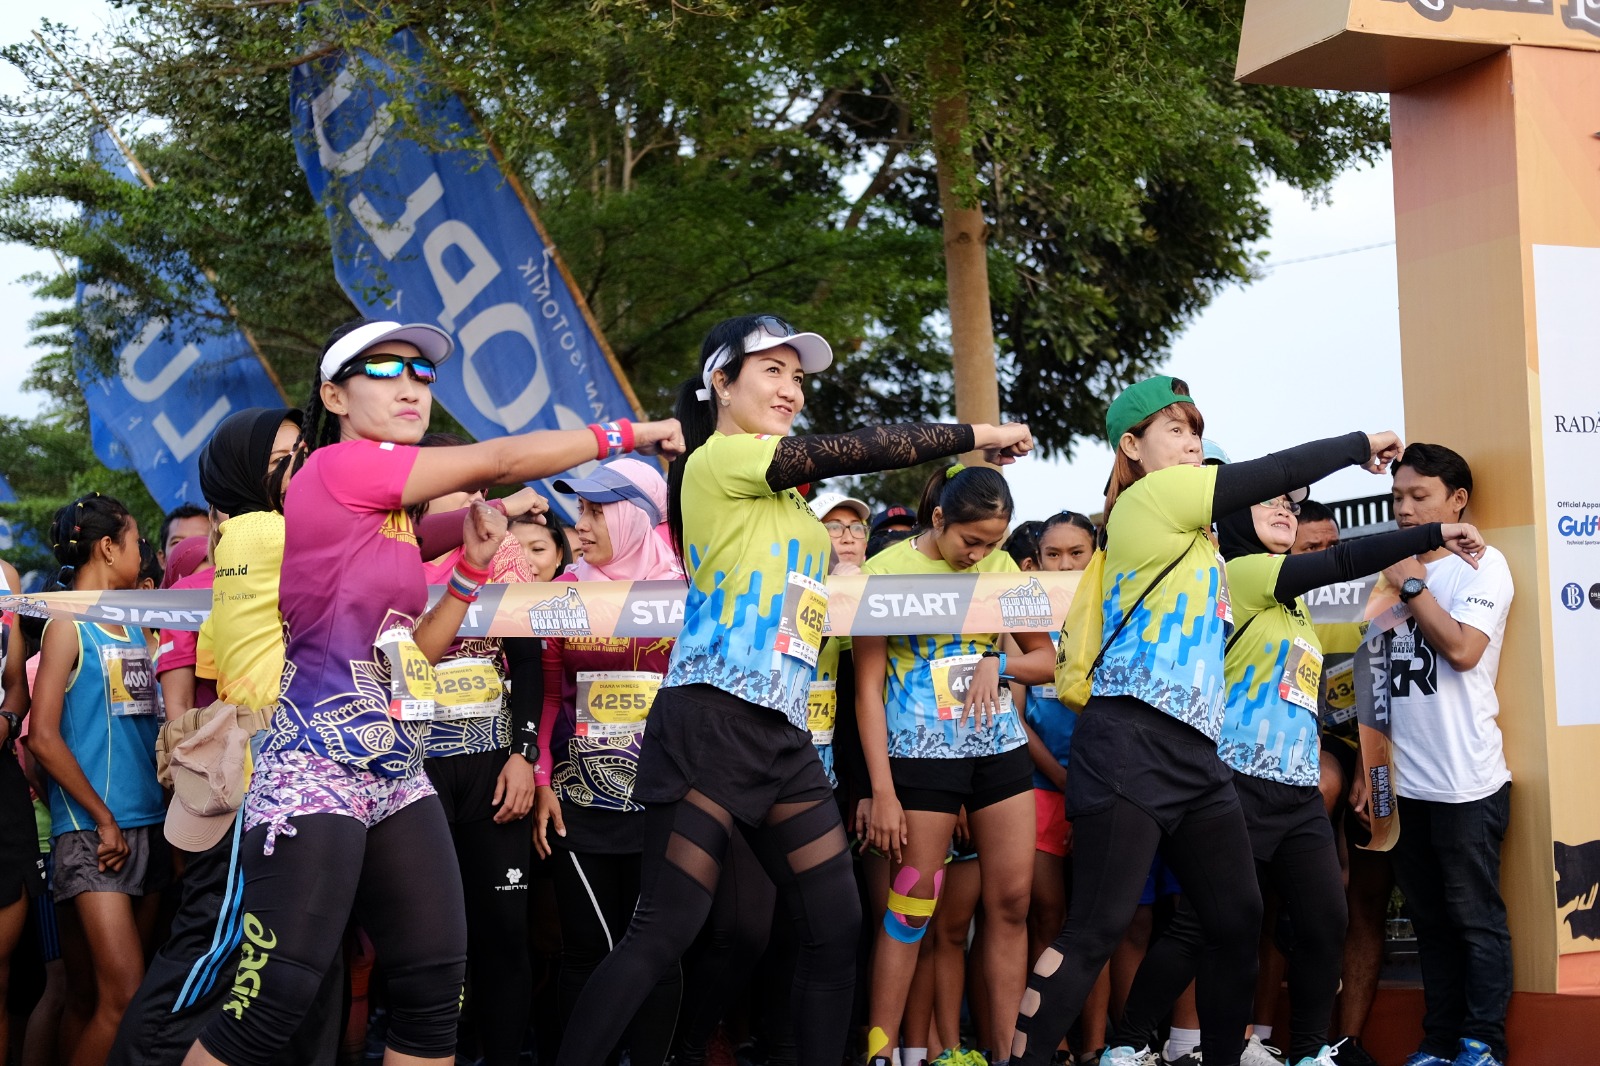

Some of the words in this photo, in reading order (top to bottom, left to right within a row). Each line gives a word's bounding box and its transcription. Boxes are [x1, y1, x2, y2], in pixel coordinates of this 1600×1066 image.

[1582, 501, 1600, 509] Appa
[1558, 514, 1600, 537] Gulf
[1301, 581, 1367, 606] TART
[868, 592, 960, 618] START
[1466, 596, 1495, 609] KVRR
[529, 609, 553, 619] KELUD
[553, 605, 587, 619] VOLCANO
[632, 599, 684, 626] STA
[1001, 605, 1027, 617] ROAD
[1028, 604, 1052, 616] RUN
[531, 618, 561, 630] ROAD
[562, 618, 589, 629] RUN
[781, 616, 789, 626] F
[800, 605, 824, 633] 425
[1283, 671, 1291, 679] F
[1366, 633, 1389, 725] START
[392, 681, 400, 691] F
[435, 676, 487, 695] 4263
[951, 675, 974, 693] 40
[937, 694, 943, 702] F
[1327, 683, 1355, 701] 43
[591, 693, 647, 710] 4255
[576, 709, 583, 717] F
[807, 703, 830, 718] 574
